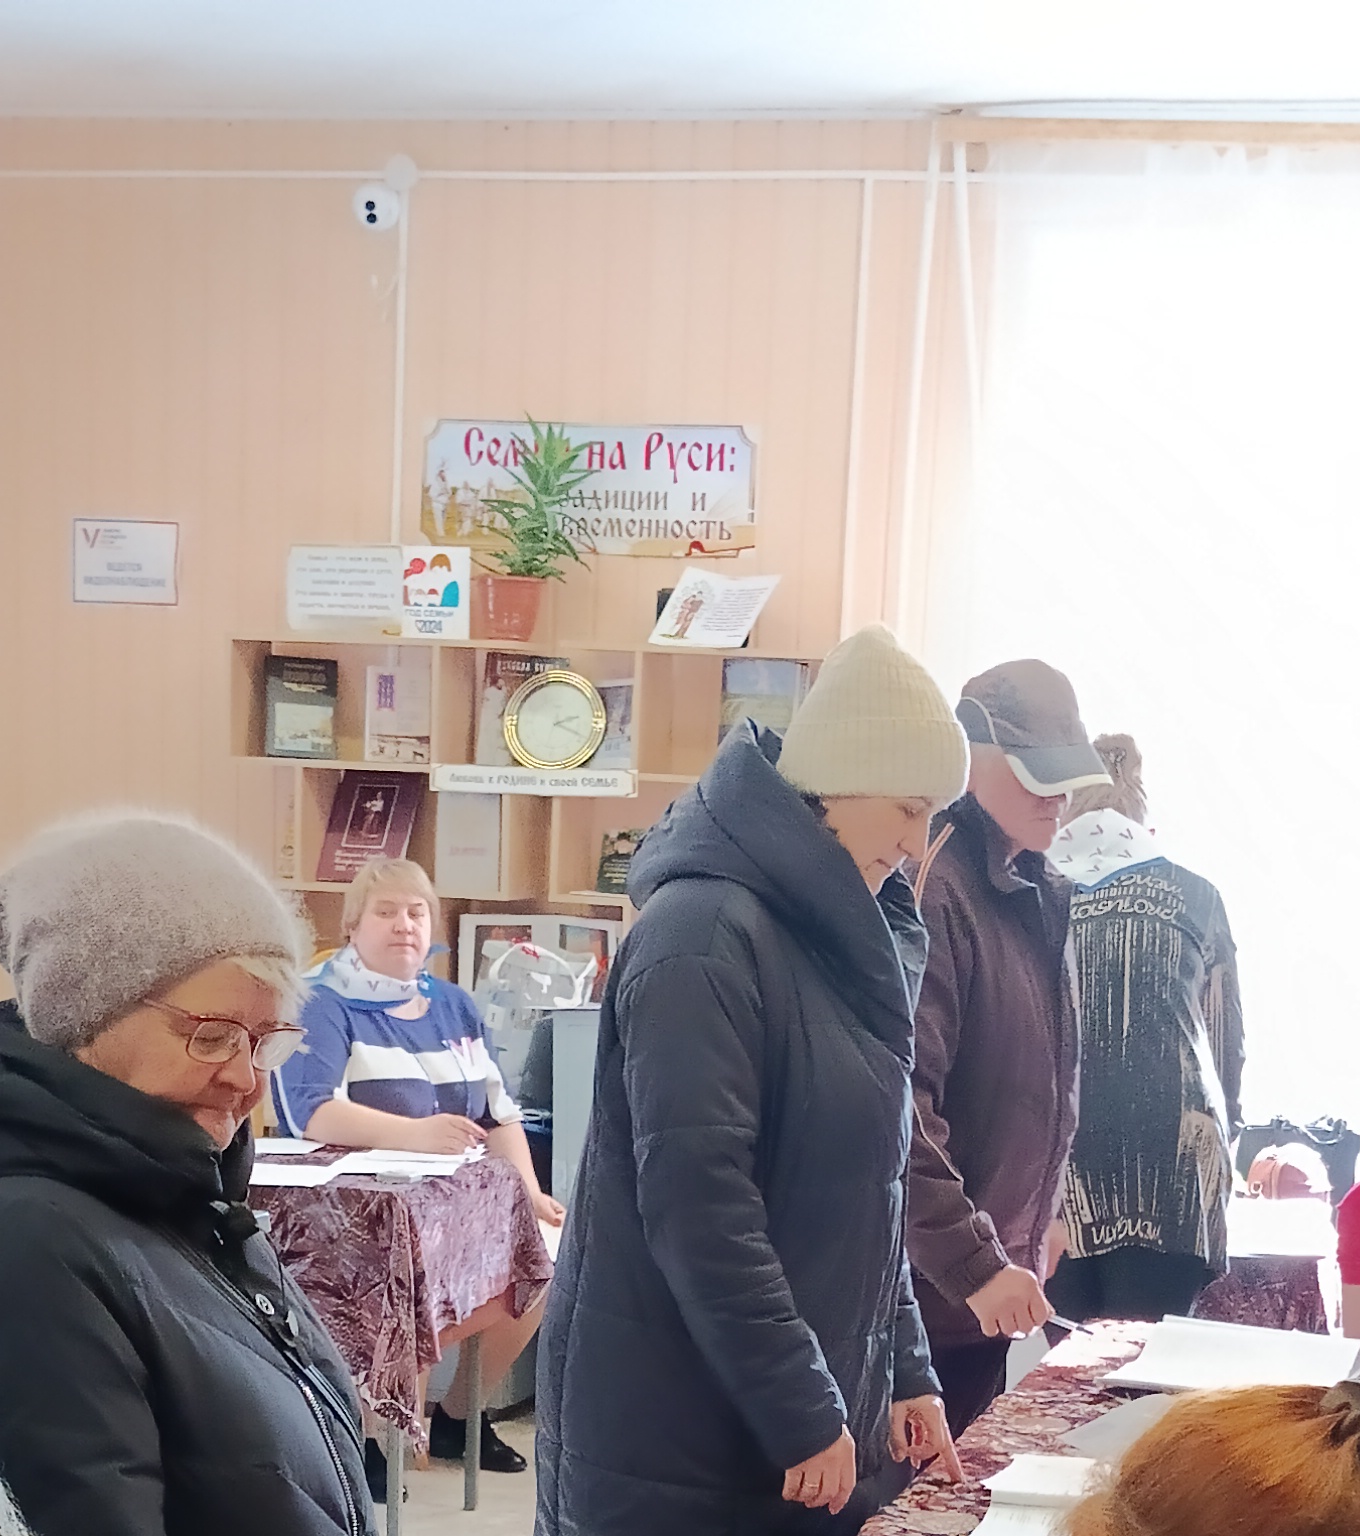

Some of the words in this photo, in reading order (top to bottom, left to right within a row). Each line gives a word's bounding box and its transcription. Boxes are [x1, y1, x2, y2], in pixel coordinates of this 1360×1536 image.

[586, 441, 627, 470] на
[643, 432, 736, 485] Руси:
[691, 492, 707, 512] и
